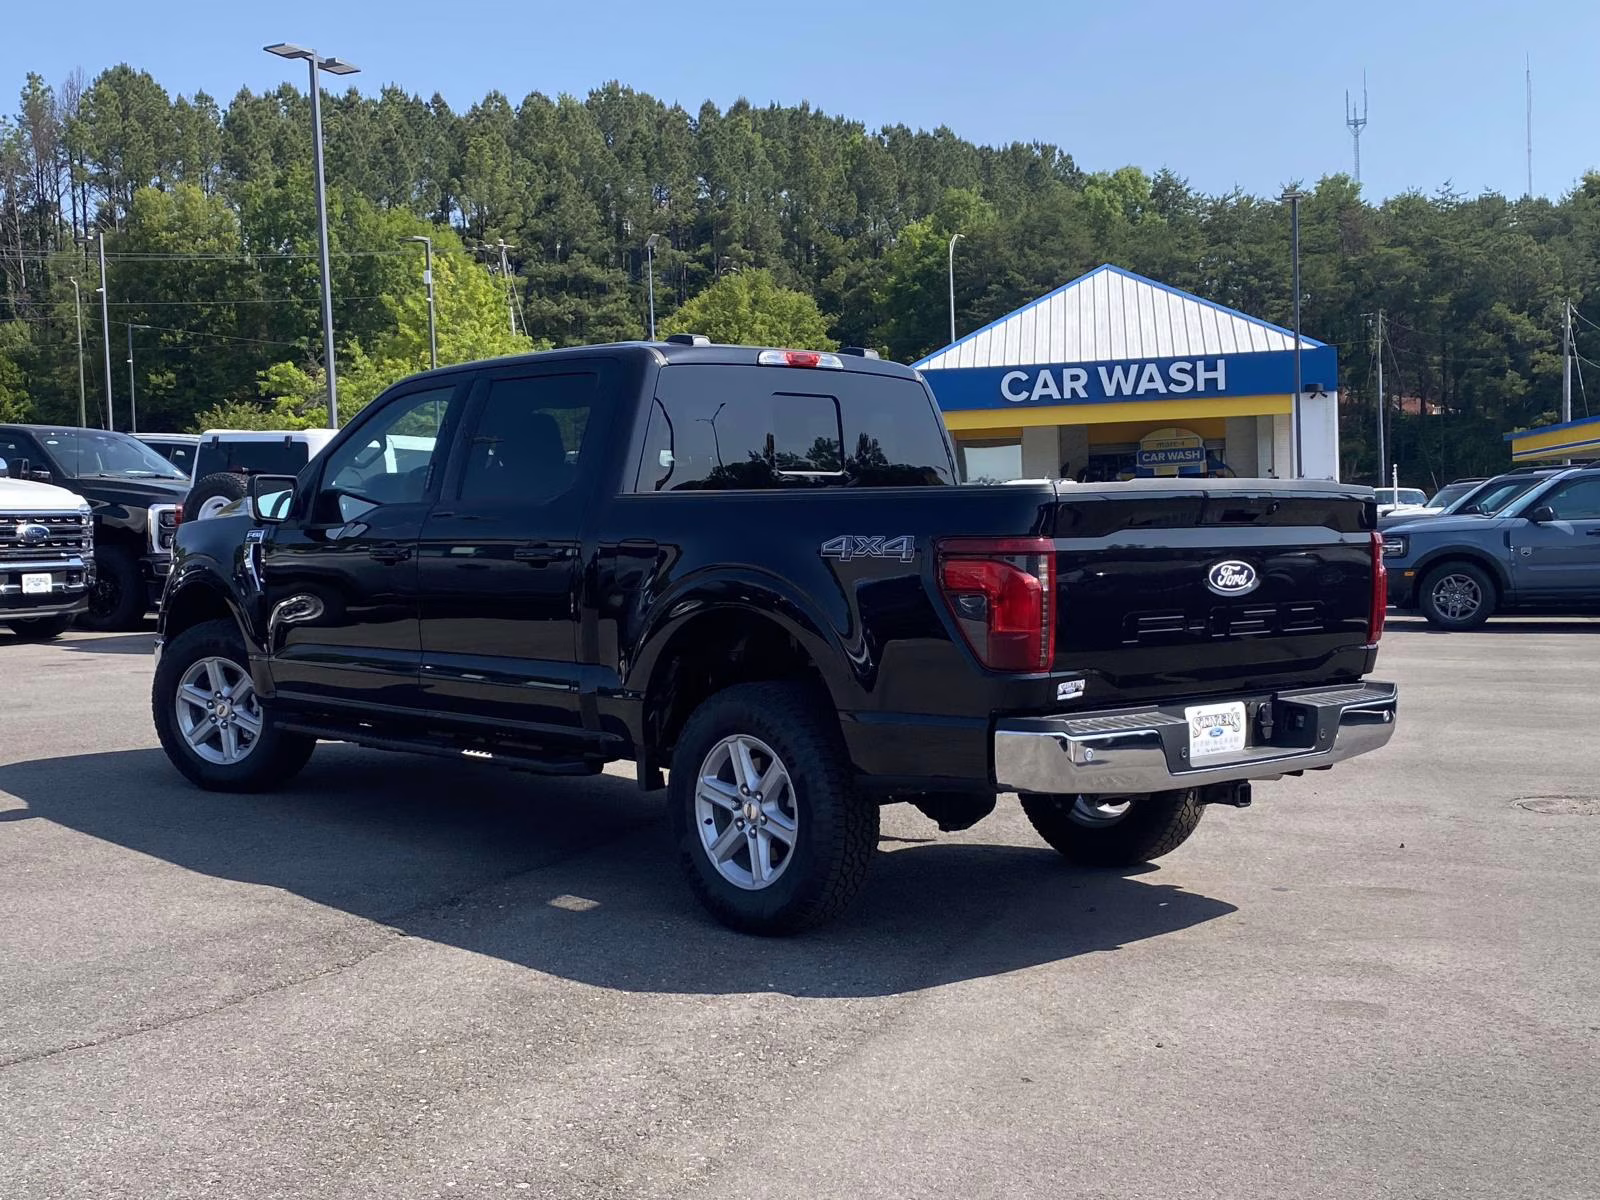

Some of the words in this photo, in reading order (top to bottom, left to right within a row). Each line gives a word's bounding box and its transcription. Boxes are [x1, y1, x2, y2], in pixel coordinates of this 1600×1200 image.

[1001, 367, 1088, 402] CAR
[1097, 359, 1226, 397] WASH
[1142, 452, 1166, 462] CAR
[1167, 450, 1200, 460] WASH
[1192, 711, 1241, 739] STIVERS
